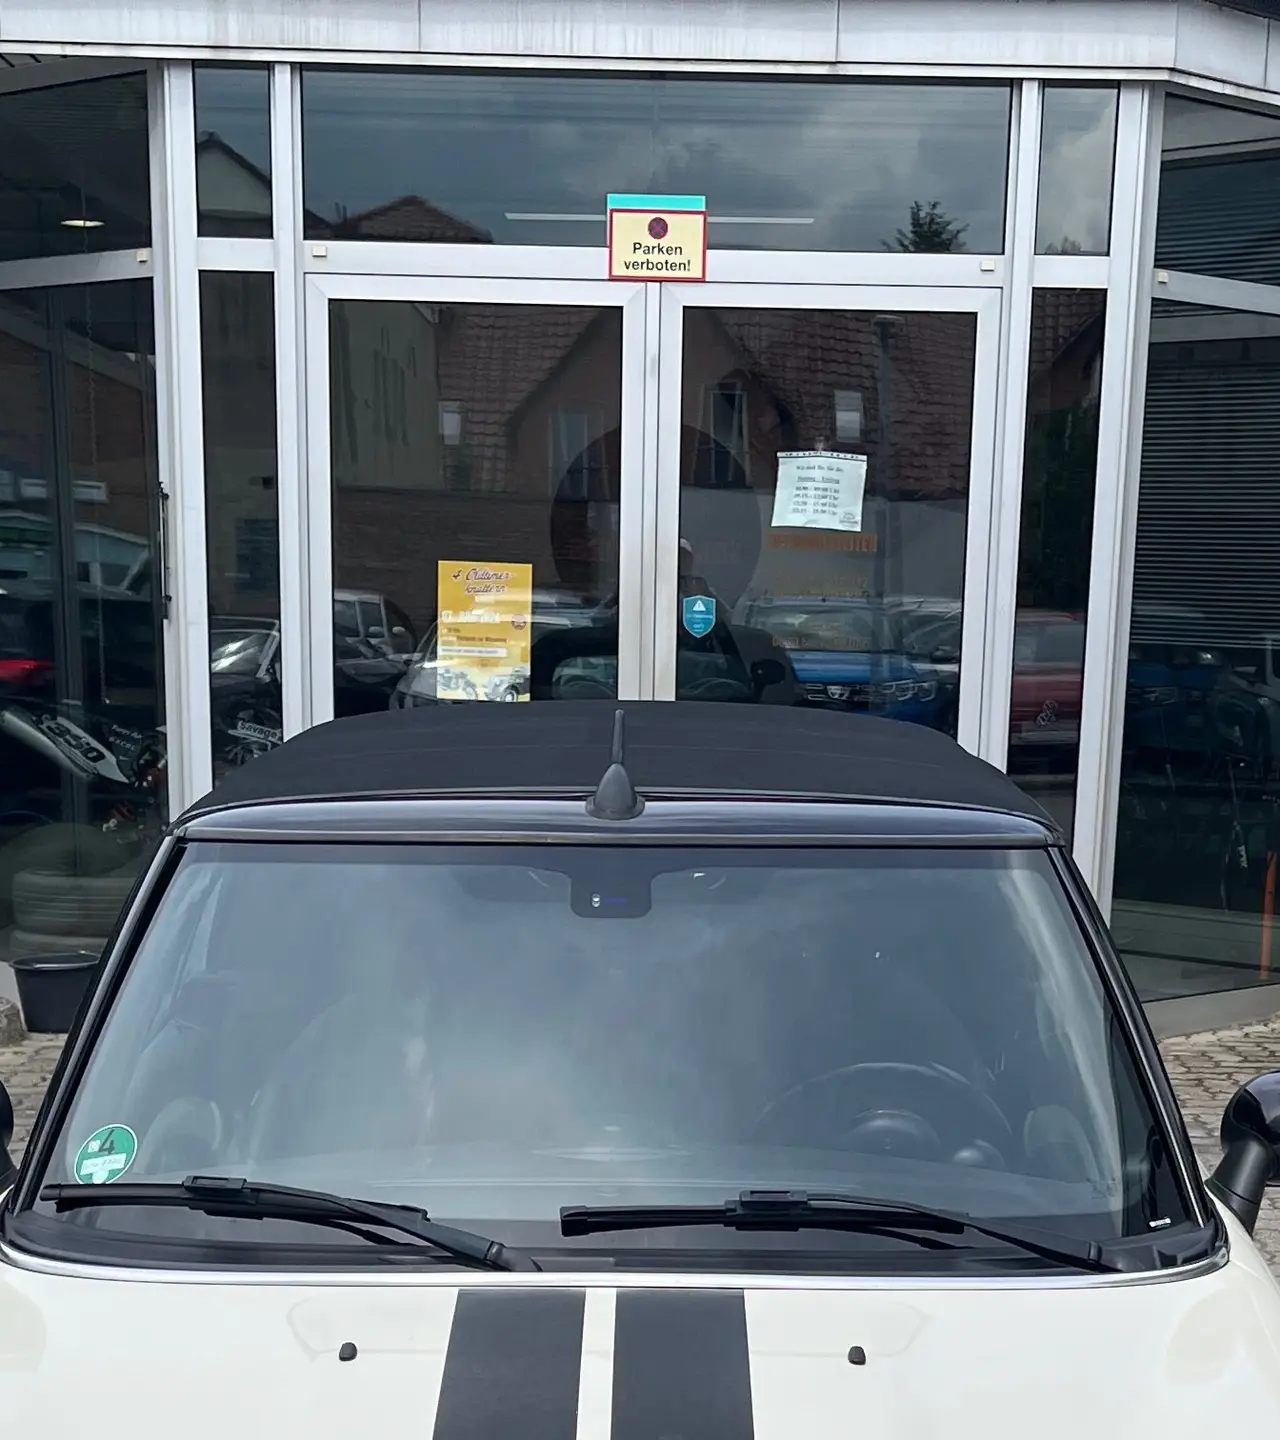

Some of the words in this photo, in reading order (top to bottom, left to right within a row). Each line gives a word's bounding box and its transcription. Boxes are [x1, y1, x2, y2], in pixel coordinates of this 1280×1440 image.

[633, 242, 683, 256] Parken
[624, 258, 691, 272] verboten!
[239, 721, 278, 740] Savage
[98, 1129, 115, 1155] 4
